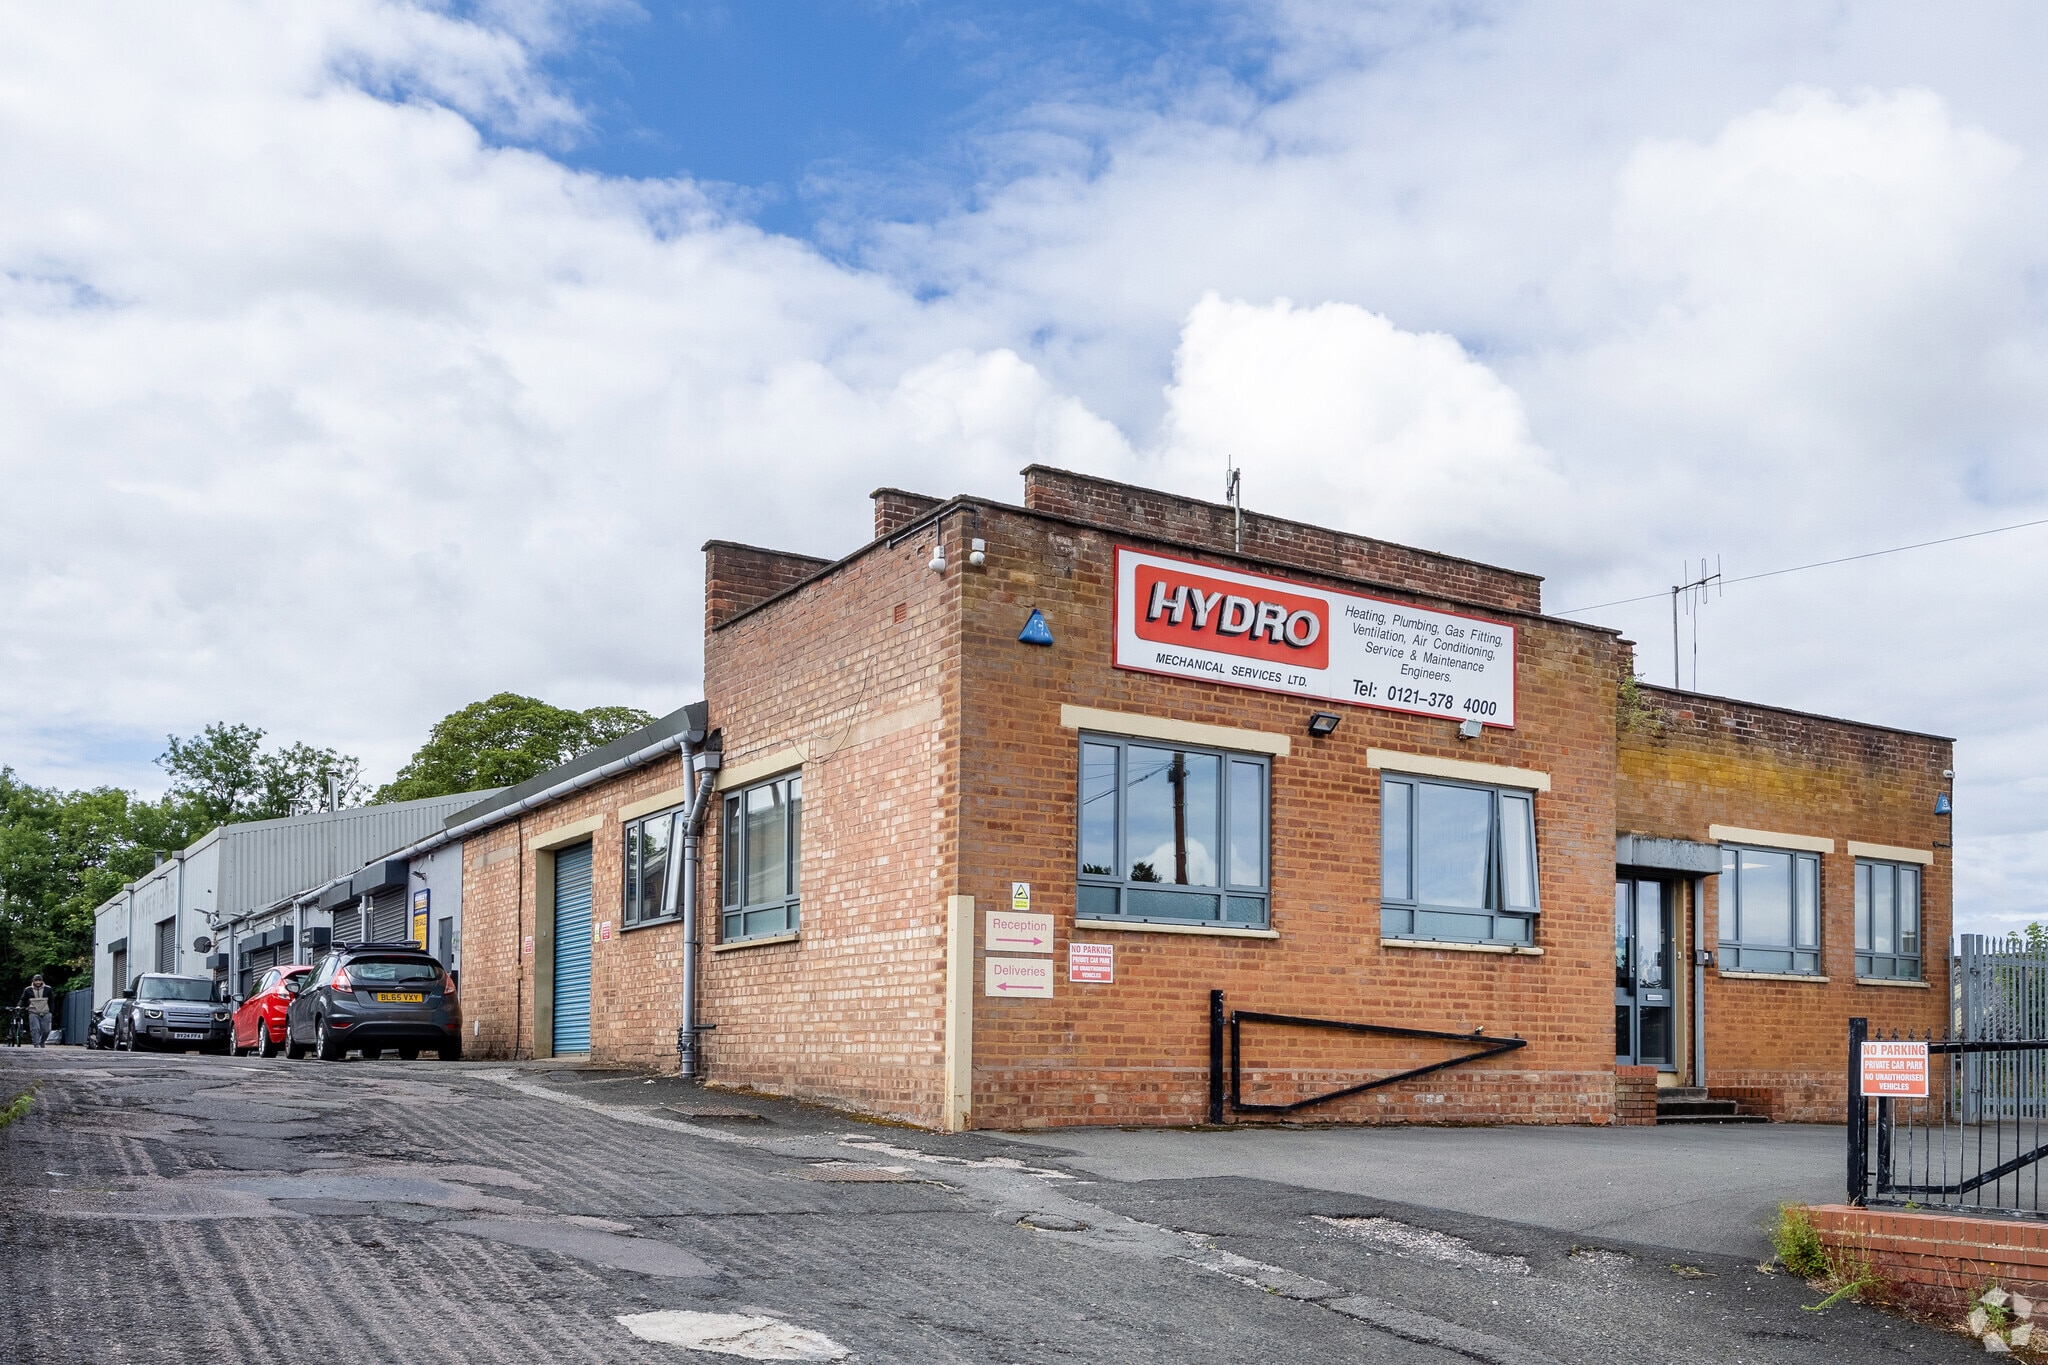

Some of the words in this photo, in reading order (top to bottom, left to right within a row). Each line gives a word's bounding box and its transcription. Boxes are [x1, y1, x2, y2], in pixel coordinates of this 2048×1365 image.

[1147, 581, 1321, 648] HYDRO
[1344, 604, 1387, 626] Heating,
[1392, 614, 1440, 636] Plumbing,
[1444, 624, 1465, 638] Gas
[1470, 628, 1503, 648] Fitting,
[1353, 622, 1406, 645] Ventilation,
[1412, 634, 1428, 647] Air
[1433, 637, 1496, 662] Conditioning,
[1364, 641, 1404, 659] Service
[1409, 649, 1417, 661] &
[1422, 651, 1485, 673] Maintenance
[1155, 652, 1225, 674] MECHANICAL
[1231, 665, 1282, 683] SERVICES
[1287, 674, 1308, 687] LTD.
[1400, 663, 1452, 683] Engineers.
[1353, 679, 1378, 698] Tel:
[1463, 698, 1497, 716] 4000
[993, 918, 1047, 933] Reception
[1071, 945, 1081, 953] NO
[1083, 945, 1112, 955] PARKING
[994, 964, 1046, 977] Deliveries
[381, 993, 402, 1001] BL65
[403, 993, 419, 1001] VXY
[1863, 1044, 1877, 1055] NO
[1881, 1044, 1926, 1056] PARKING
[1864, 1060, 1890, 1070] PRIVATE
[1891, 1060, 1905, 1070] CAR
[1906, 1060, 1924, 1070] PARK
[1864, 1073, 1874, 1081] NO
[1875, 1073, 1924, 1082] UNAUTHORISED
[1879, 1082, 1910, 1091] VEHICLES
